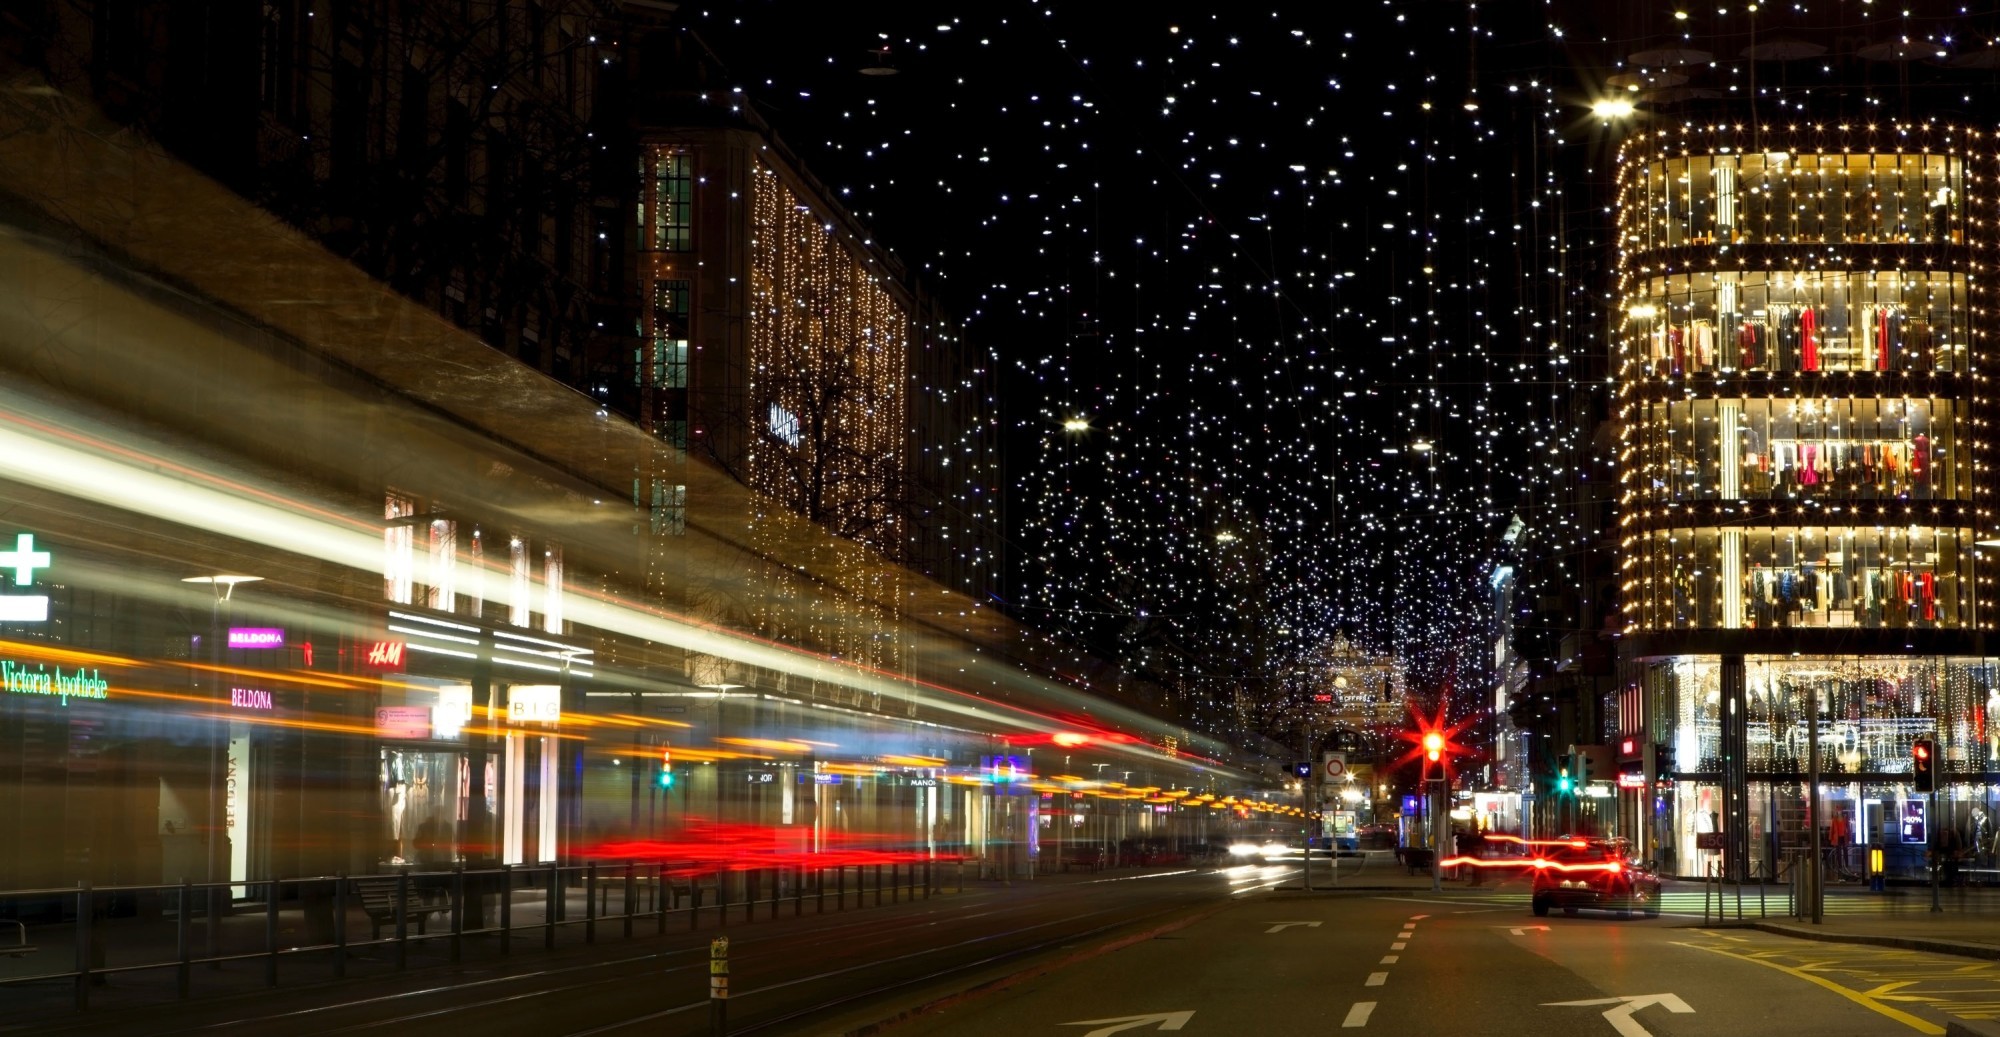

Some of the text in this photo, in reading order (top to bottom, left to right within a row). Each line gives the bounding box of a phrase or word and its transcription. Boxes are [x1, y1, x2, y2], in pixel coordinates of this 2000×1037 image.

[230, 632, 282, 643] BELDONA
[369, 641, 402, 666] H&M
[1, 660, 107, 706] Victoria Apotheke
[231, 688, 272, 709] BELDONA
[226, 757, 237, 828] BELDONA
